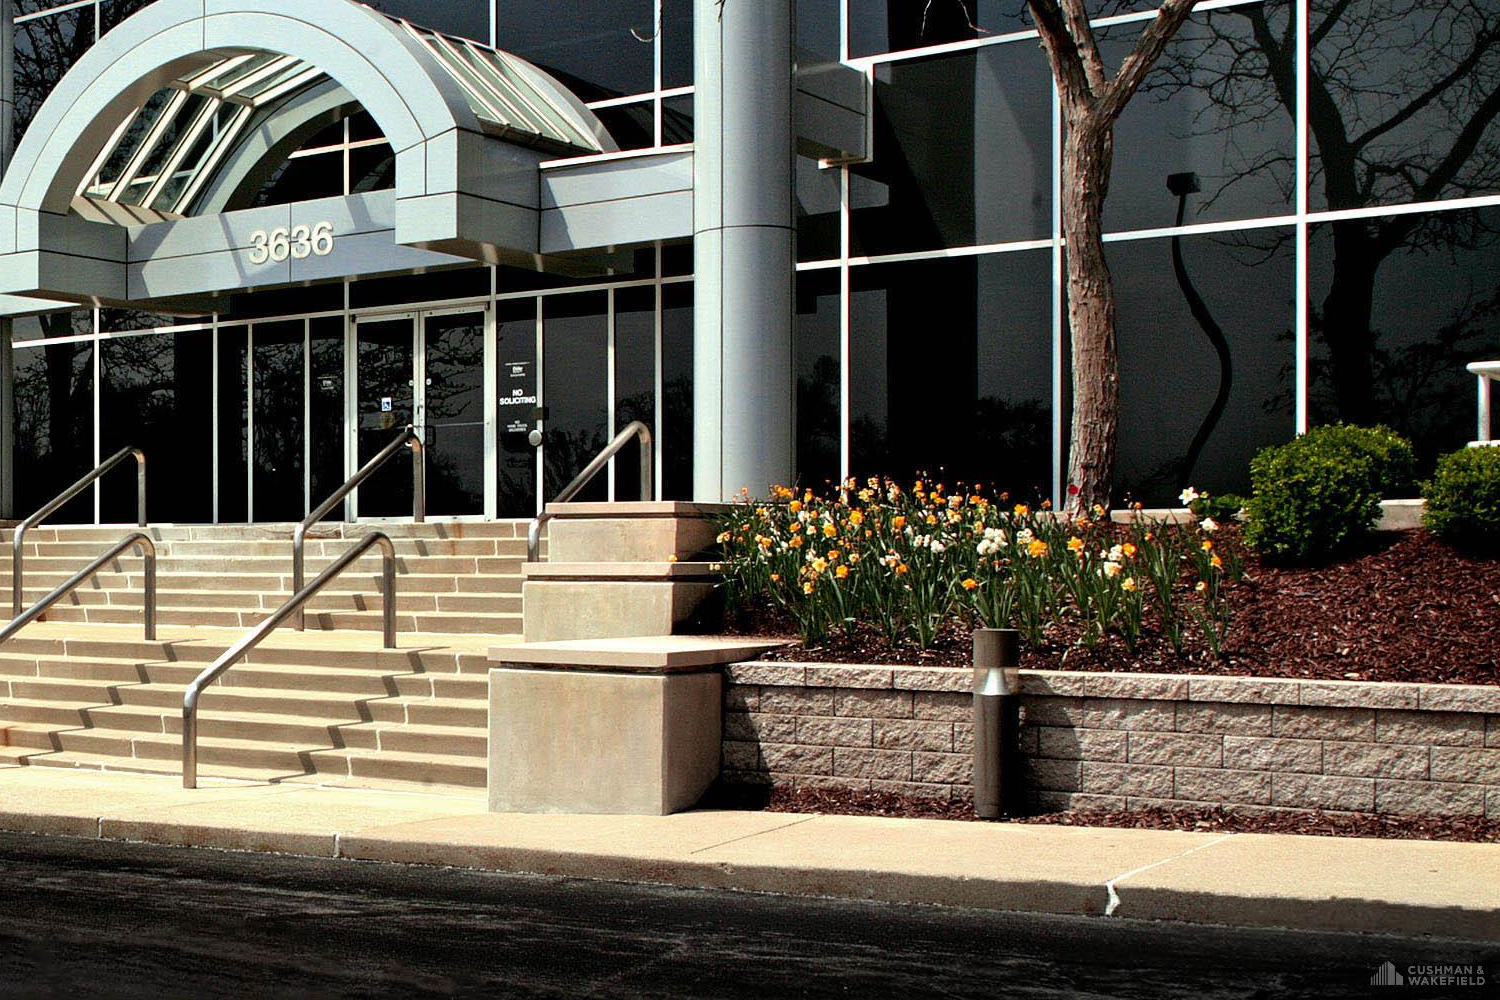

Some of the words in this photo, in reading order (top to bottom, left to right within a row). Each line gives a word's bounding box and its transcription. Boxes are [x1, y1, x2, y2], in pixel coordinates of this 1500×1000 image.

[250, 221, 334, 265] 3636
[512, 389, 523, 397] NO
[499, 396, 536, 405] SOLICITING
